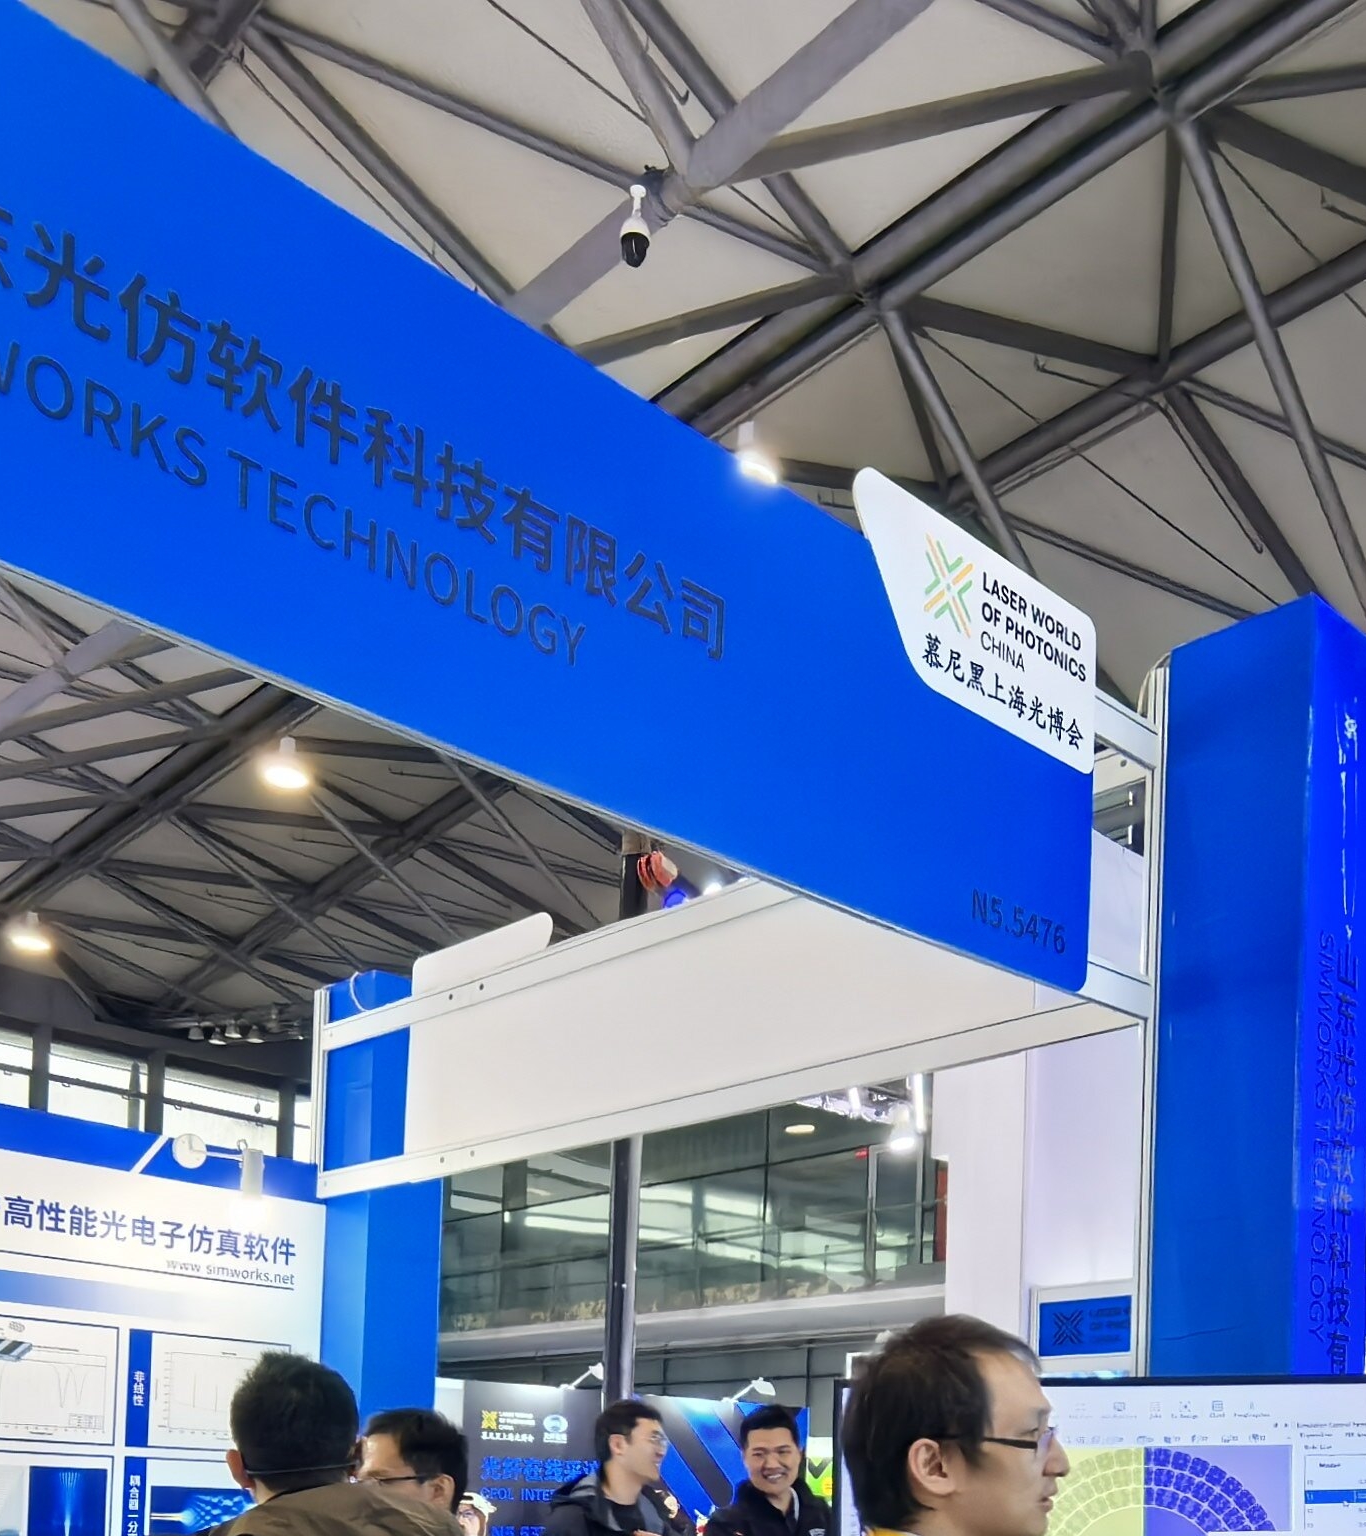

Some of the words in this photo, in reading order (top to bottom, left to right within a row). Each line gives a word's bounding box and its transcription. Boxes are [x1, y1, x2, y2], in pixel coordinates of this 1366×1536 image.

[227, 448, 587, 667] TECHNOLOGY
[981, 571, 1028, 618] LASER
[1030, 603, 1082, 652] WORLD
[981, 602, 1002, 630] OF
[1005, 618, 1086, 682] PHOTONICS
[980, 630, 1026, 673] CHINA
[921, 632, 1084, 750] 慕尼黑上海光博会
[971, 888, 1066, 955] N5.5476
[166, 1259, 295, 1286] wwwsimworks.net
[521, 1488, 555, 1501] INTE
